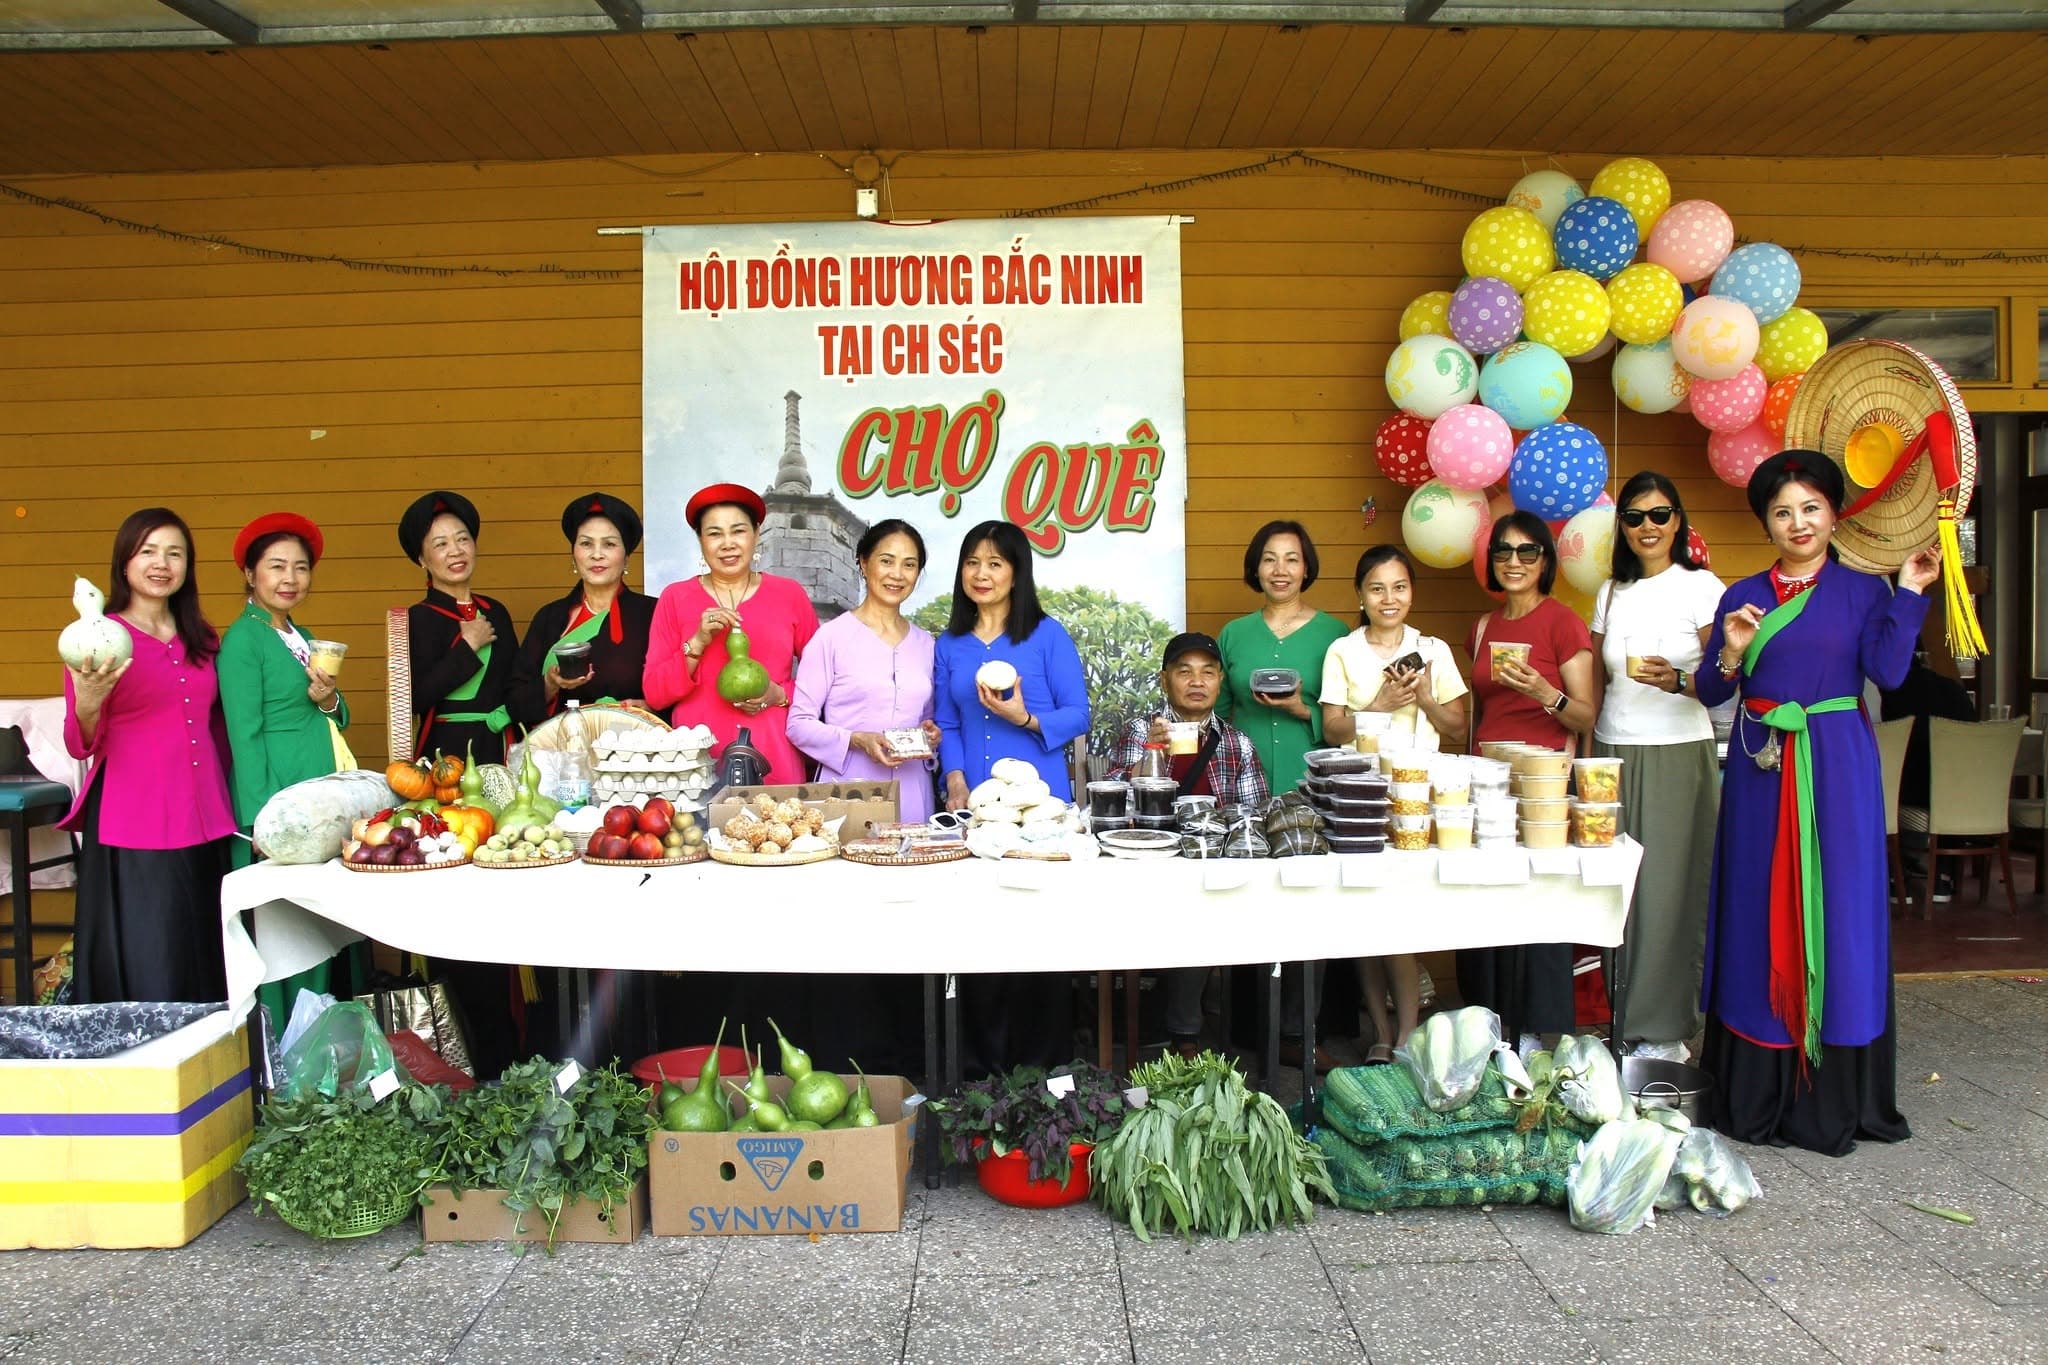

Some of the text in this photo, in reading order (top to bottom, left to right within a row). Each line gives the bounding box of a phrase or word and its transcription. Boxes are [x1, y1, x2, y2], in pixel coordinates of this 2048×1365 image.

[680, 236, 1143, 318] HỘI ĐỒNG HƯƠNG BẮC NINH
[818, 314, 1004, 384] TẠI CH SÉC
[838, 389, 1162, 555] CHỢ QUÊ
[742, 1140, 798, 1153] AMIGO
[688, 1202, 860, 1232] BANANAS
